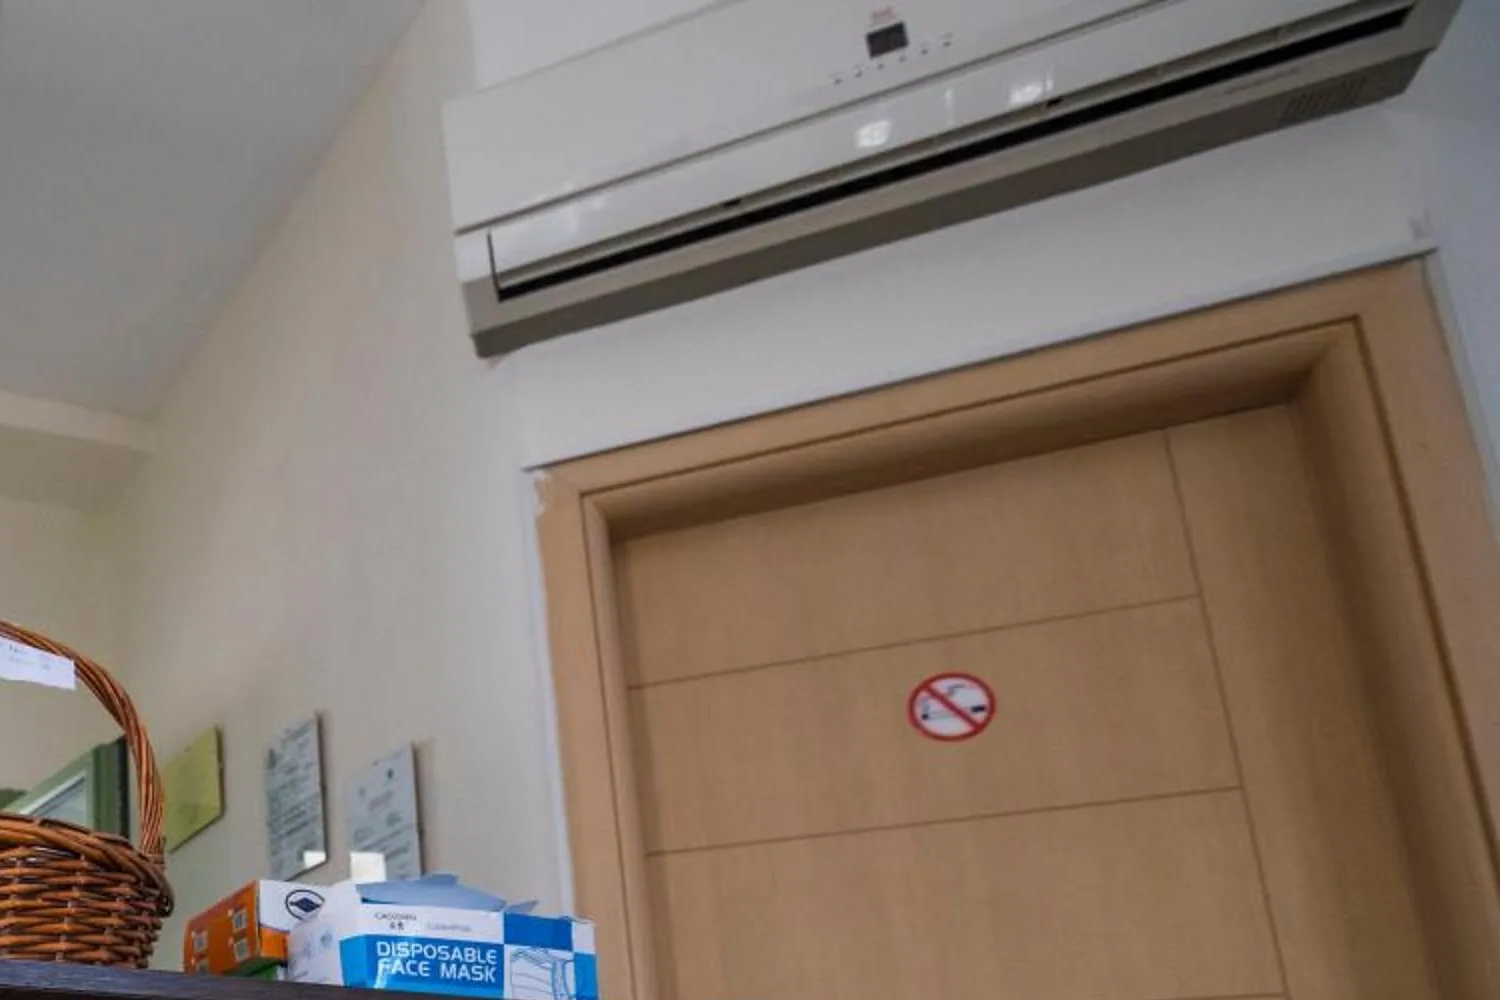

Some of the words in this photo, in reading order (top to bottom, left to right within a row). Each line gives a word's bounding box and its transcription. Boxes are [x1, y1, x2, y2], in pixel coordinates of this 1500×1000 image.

[376, 941, 497, 965] DISPOSABLE
[378, 958, 431, 977] FACE
[440, 963, 496, 983] MASK
